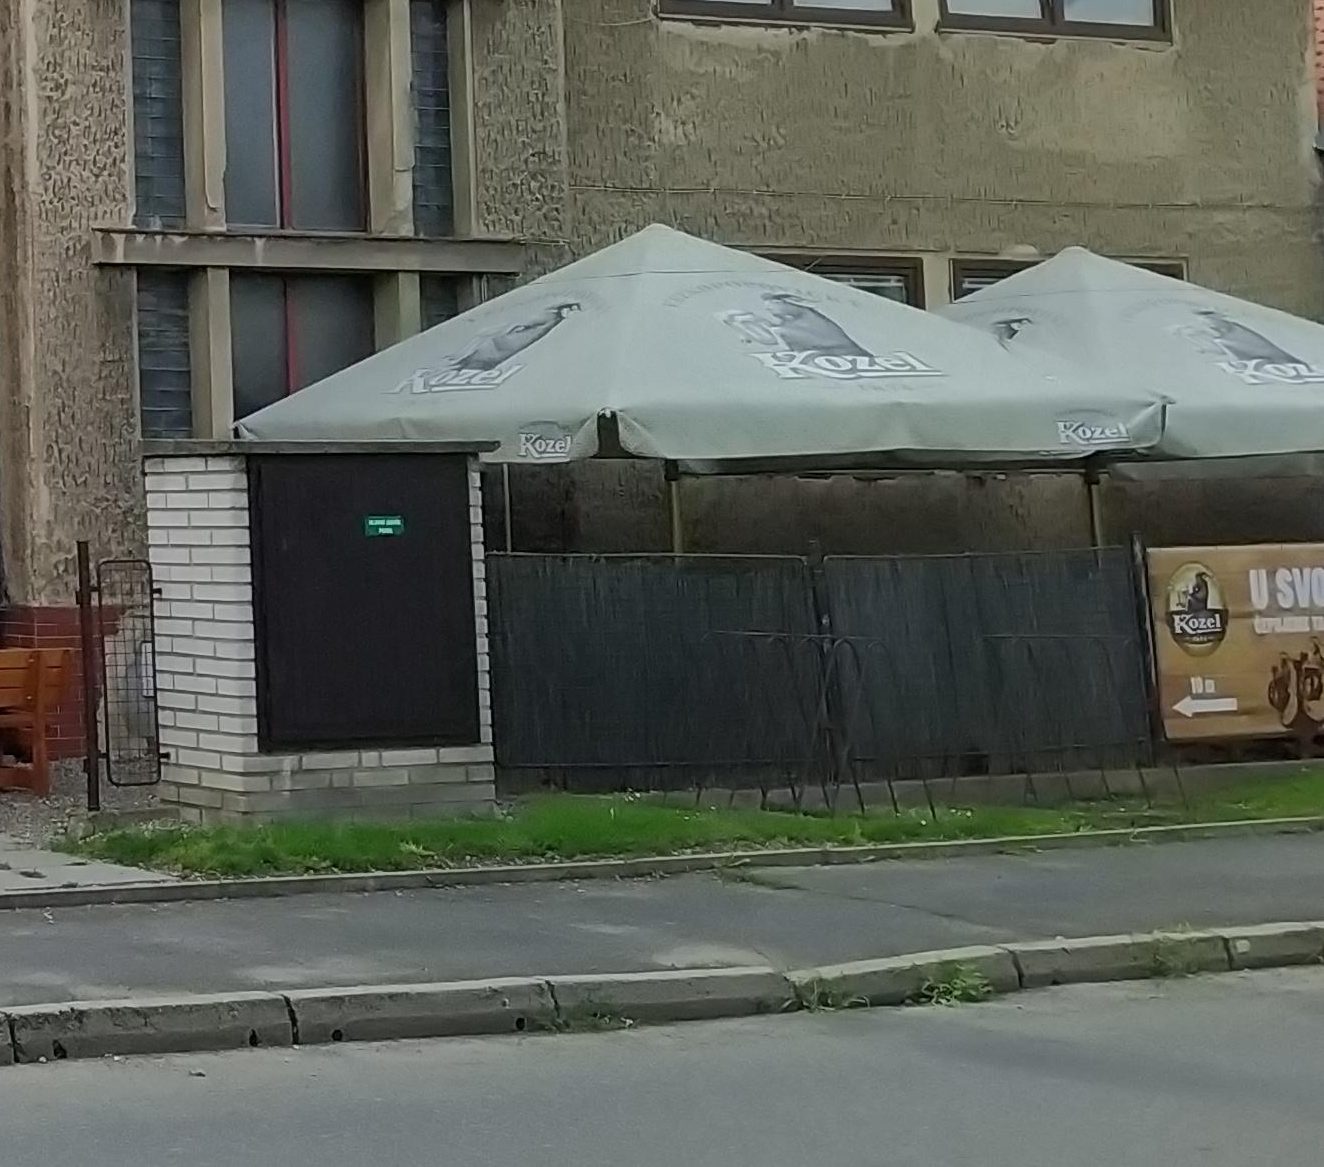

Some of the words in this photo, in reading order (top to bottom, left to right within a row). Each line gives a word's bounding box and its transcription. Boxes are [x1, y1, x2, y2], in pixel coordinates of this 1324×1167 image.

[750, 349, 950, 380] Kozel
[1215, 358, 1324, 385] Koz
[1056, 420, 1130, 445] Kozel
[519, 433, 573, 459] Kozel
[1249, 568, 1269, 610] U
[1173, 613, 1223, 634] Kozel
